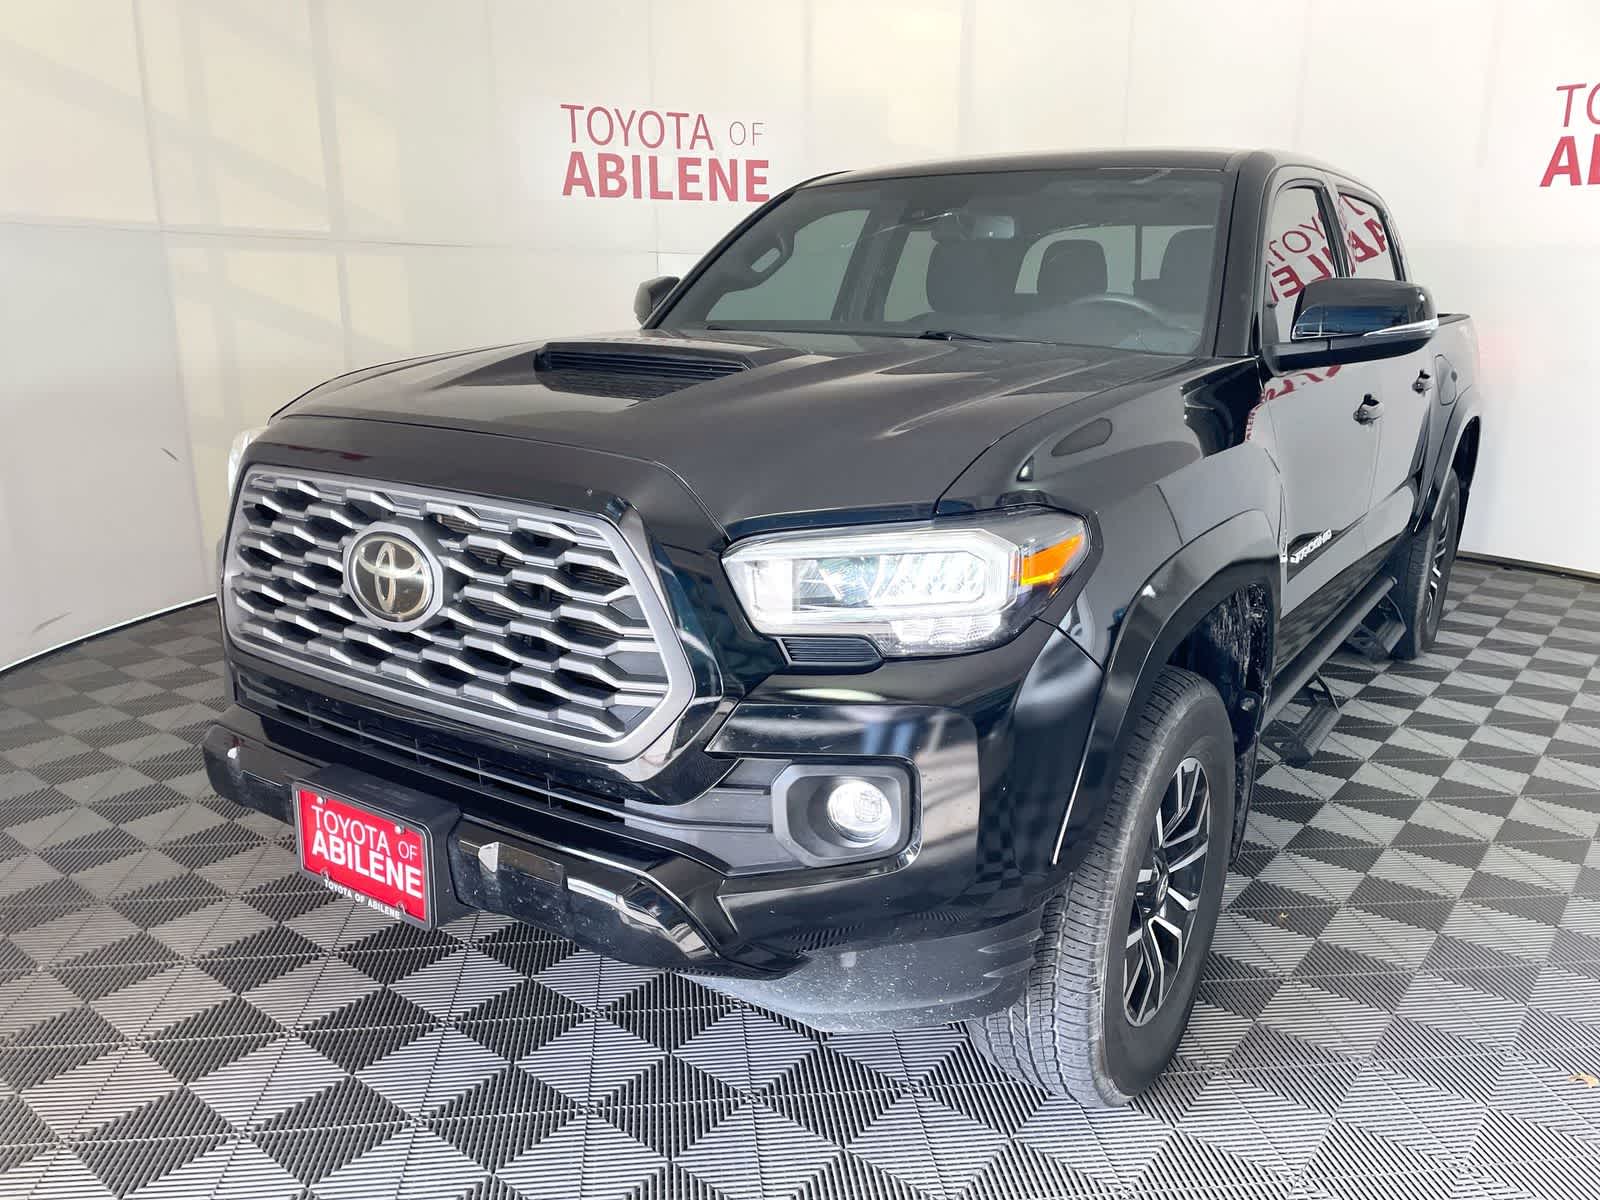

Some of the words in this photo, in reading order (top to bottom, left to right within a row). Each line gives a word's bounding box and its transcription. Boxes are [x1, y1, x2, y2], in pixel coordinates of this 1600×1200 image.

[560, 104, 714, 150] TOYOTA
[729, 121, 764, 146] OF
[562, 151, 770, 202] ABILENE
[311, 805, 391, 856] TOYOTA
[398, 840, 418, 861] OF
[311, 830, 423, 899] ABILENE
[323, 878, 353, 898] TOYOTA
[367, 898, 401, 920] ABILENE
